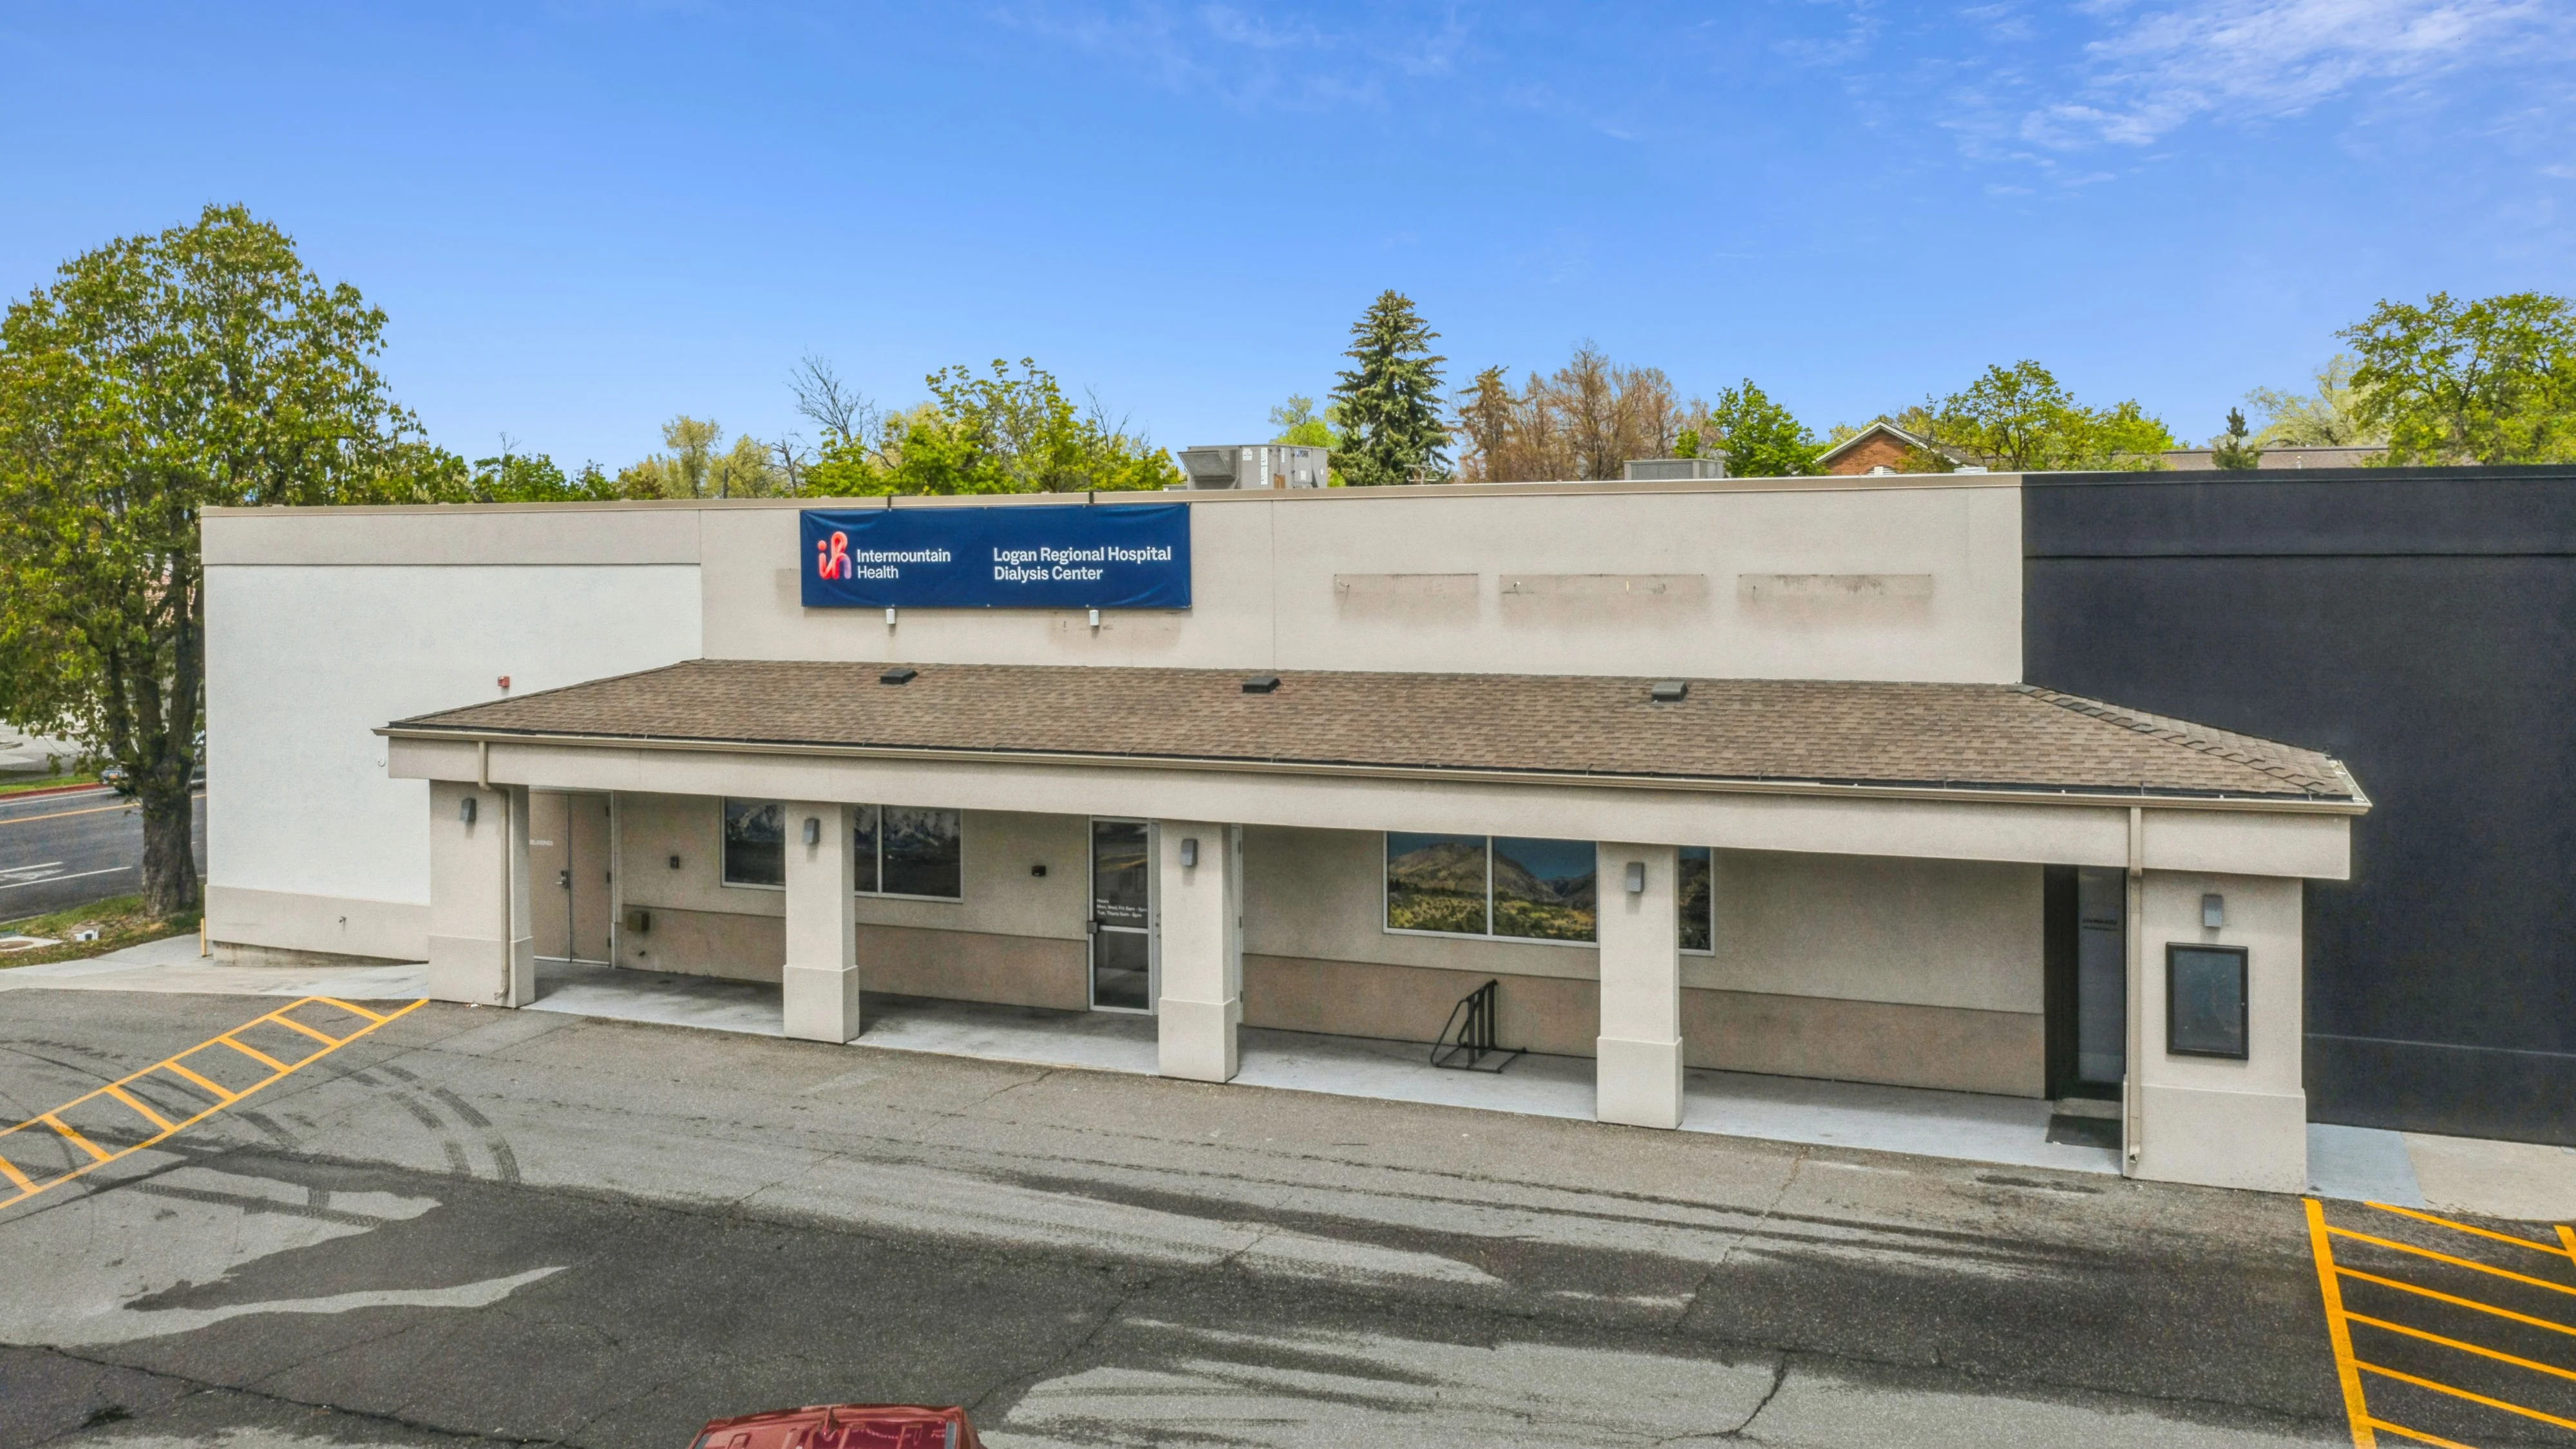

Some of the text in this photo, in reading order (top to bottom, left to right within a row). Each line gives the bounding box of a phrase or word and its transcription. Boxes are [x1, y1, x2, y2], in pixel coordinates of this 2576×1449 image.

[857, 549, 951, 563] Intermountain
[994, 546, 1171, 565] Logan Regional Hospital
[858, 565, 899, 579] Health
[994, 565, 1103, 583] Dialysis Center
